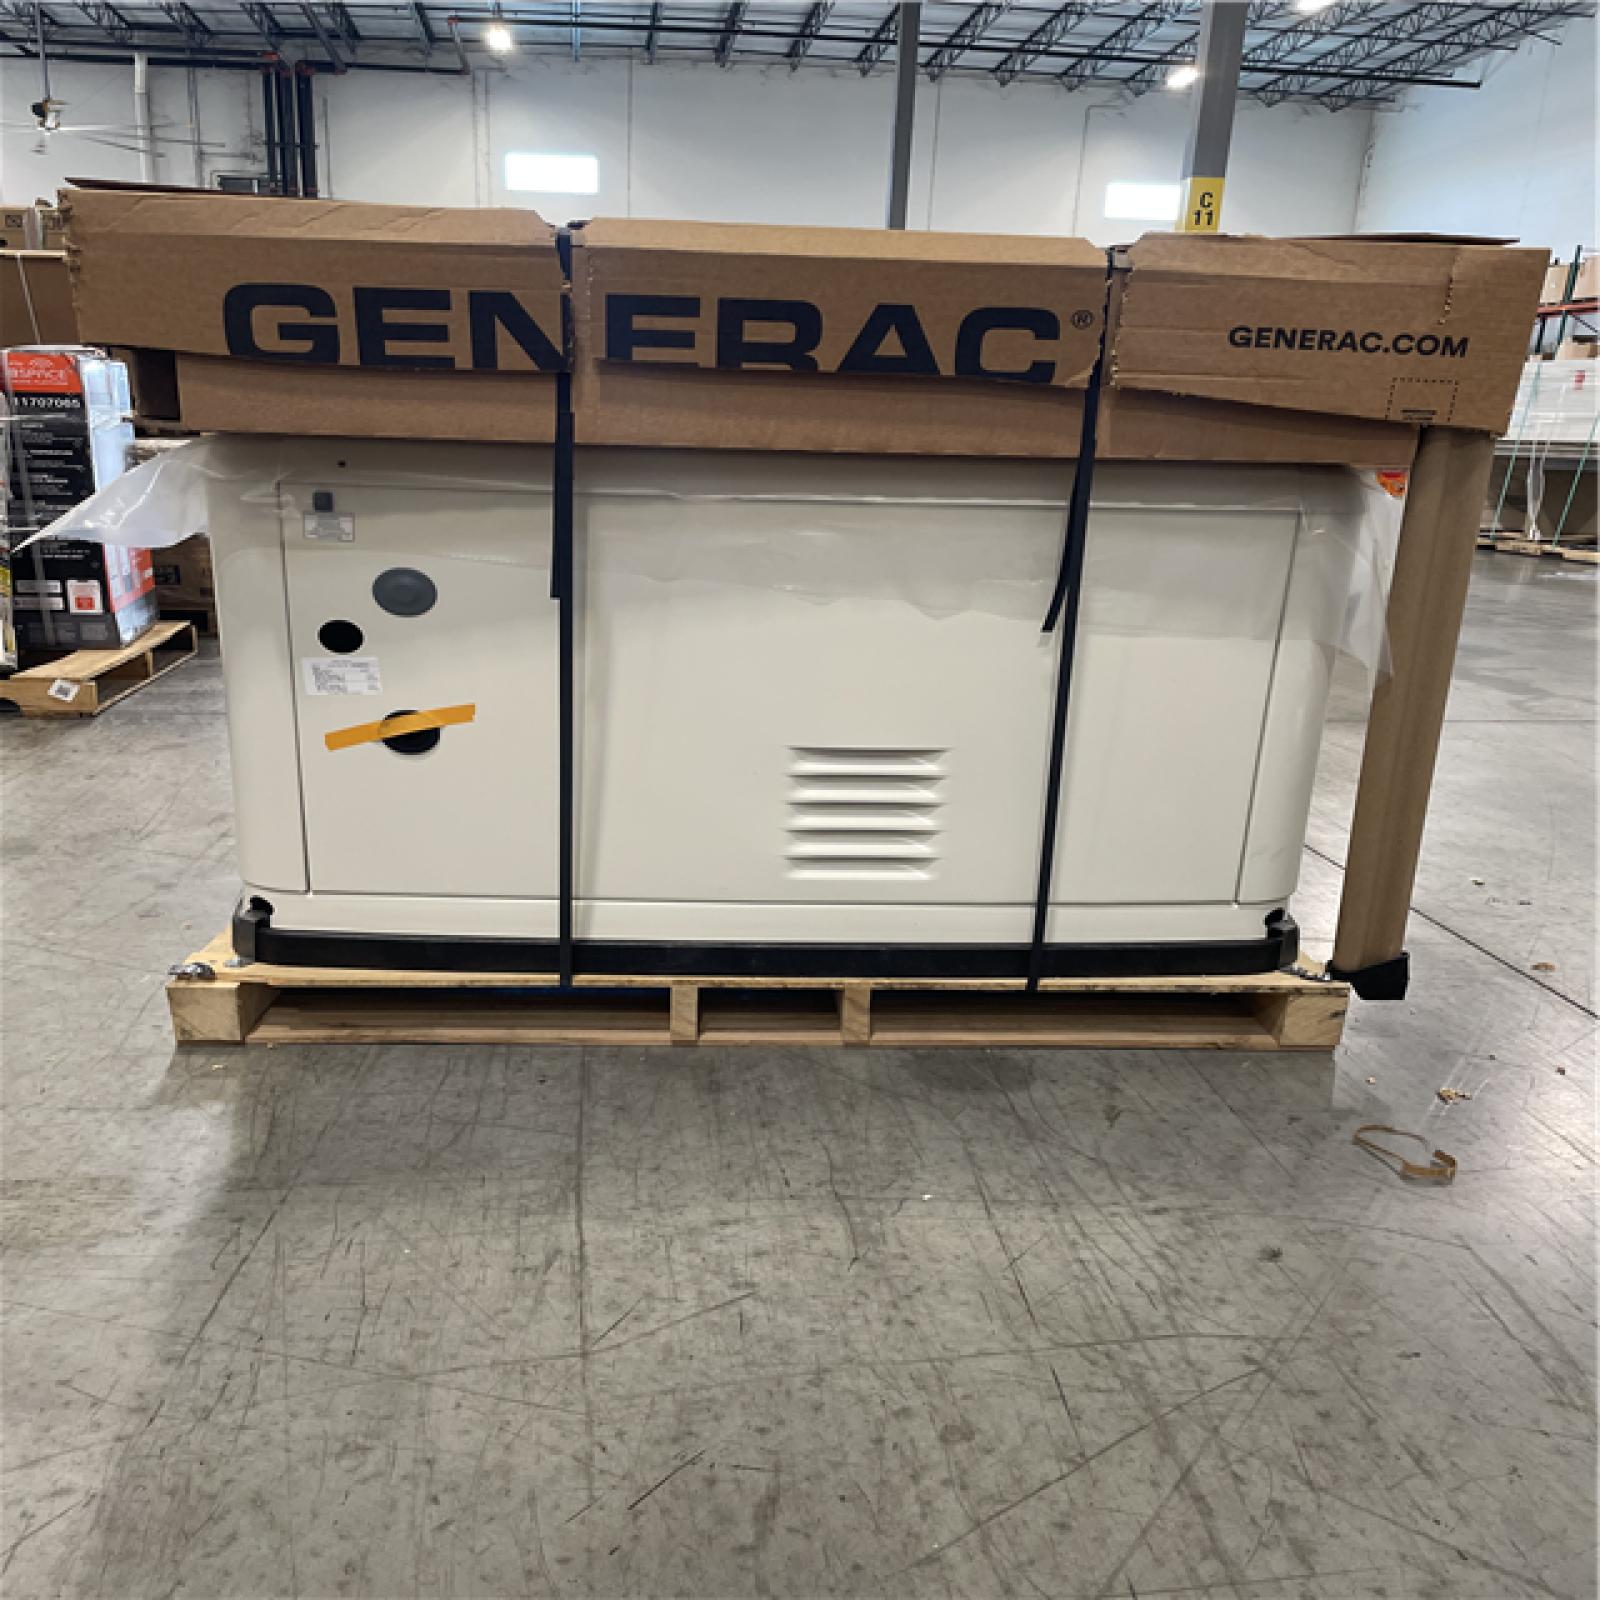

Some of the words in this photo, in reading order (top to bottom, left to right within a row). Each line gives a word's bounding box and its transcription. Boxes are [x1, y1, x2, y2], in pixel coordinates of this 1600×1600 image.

[1199, 191, 1213, 208] C
[1194, 209, 1213, 226] 11
[1229, 325, 1469, 358] GENERAC.COM
